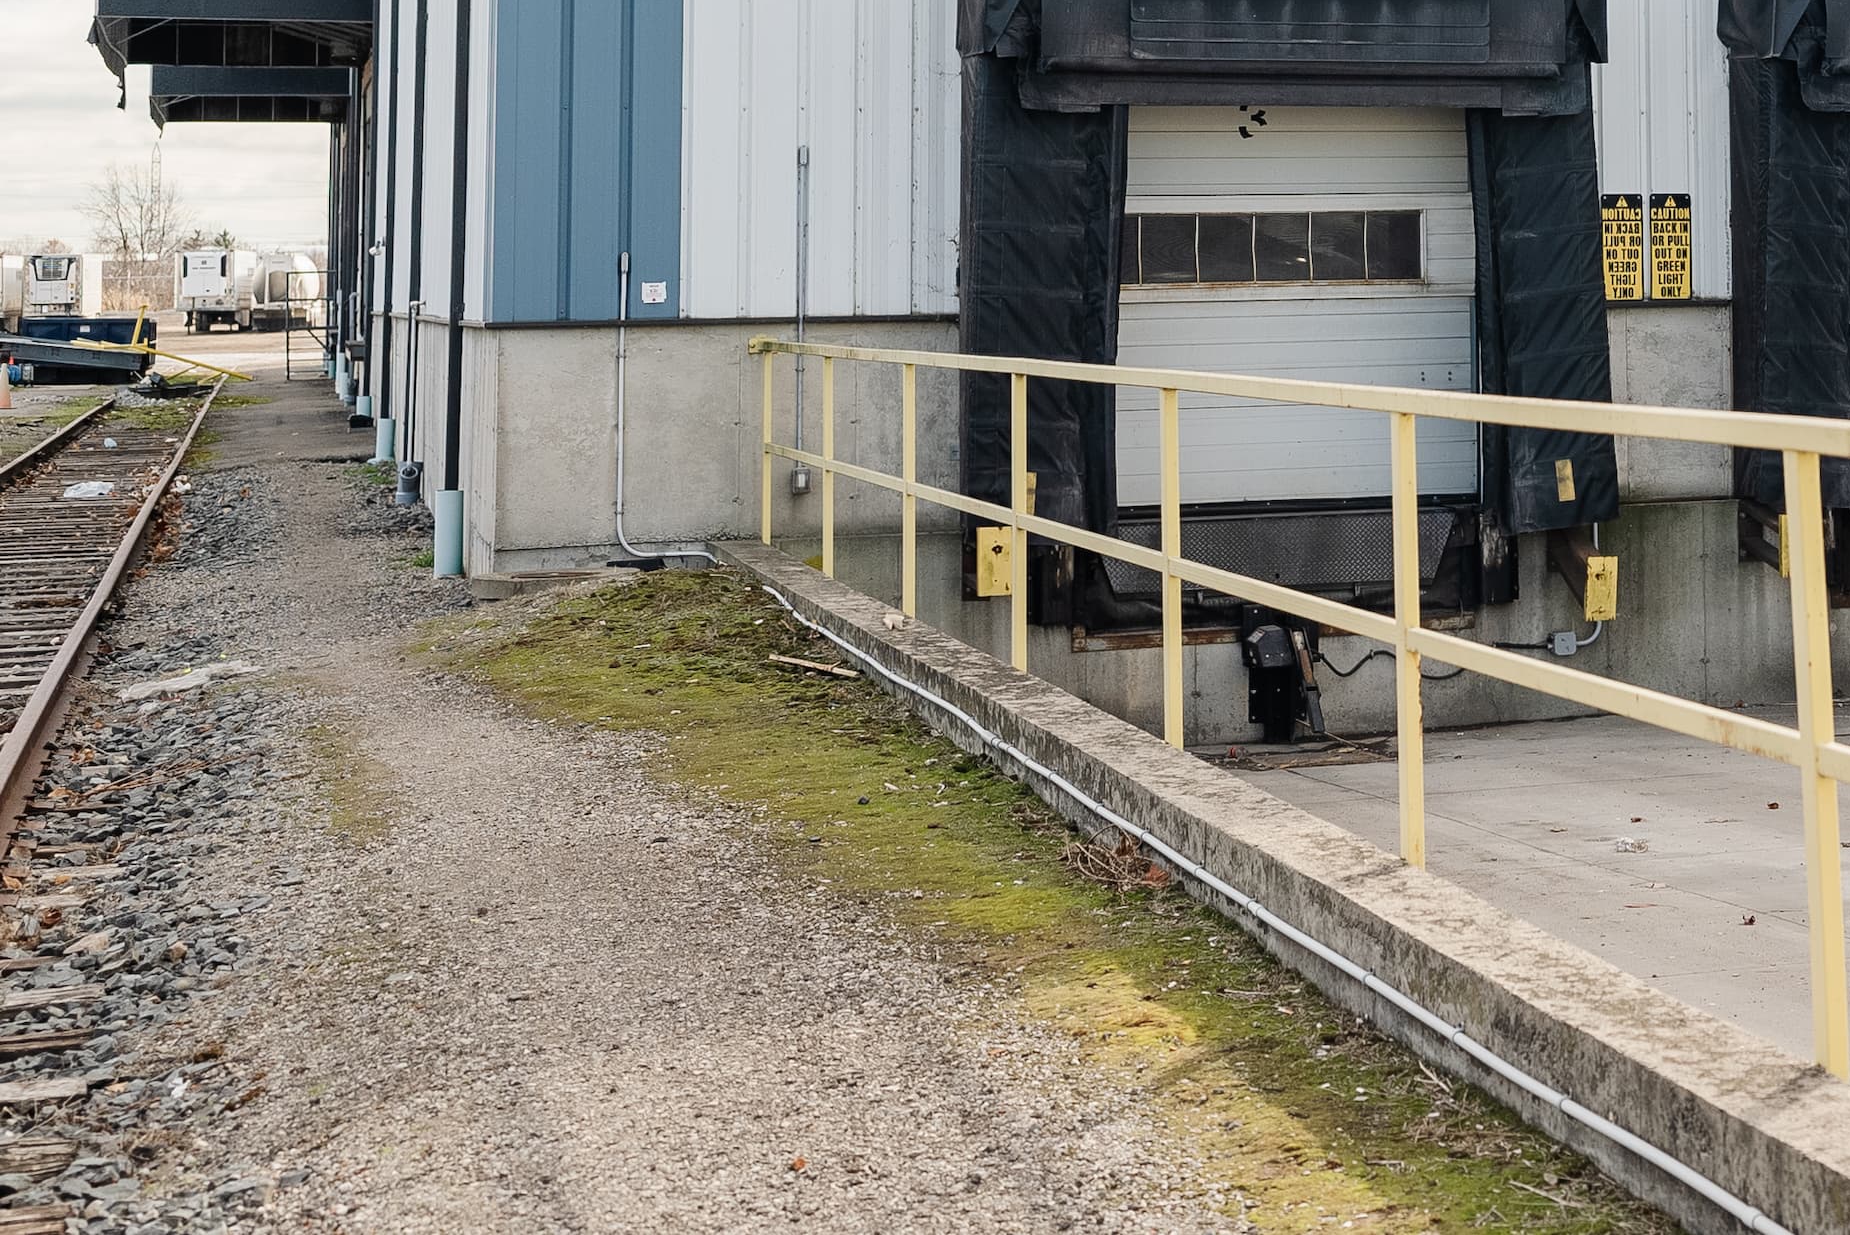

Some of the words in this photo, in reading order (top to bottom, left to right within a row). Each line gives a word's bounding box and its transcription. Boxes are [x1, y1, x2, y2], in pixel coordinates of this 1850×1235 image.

[1651, 208, 1690, 219] CAUTION
[1653, 223, 1677, 234] BACK
[1680, 223, 1688, 234] IN
[1652, 236, 1664, 247] OR
[1667, 236, 1689, 247] PULL
[1655, 248, 1672, 259] OUT
[1676, 248, 1687, 259] ON
[1657, 261, 1686, 272] GREEN
[1658, 274, 1684, 285] LIGHT
[1661, 286, 1681, 297] ONLY
